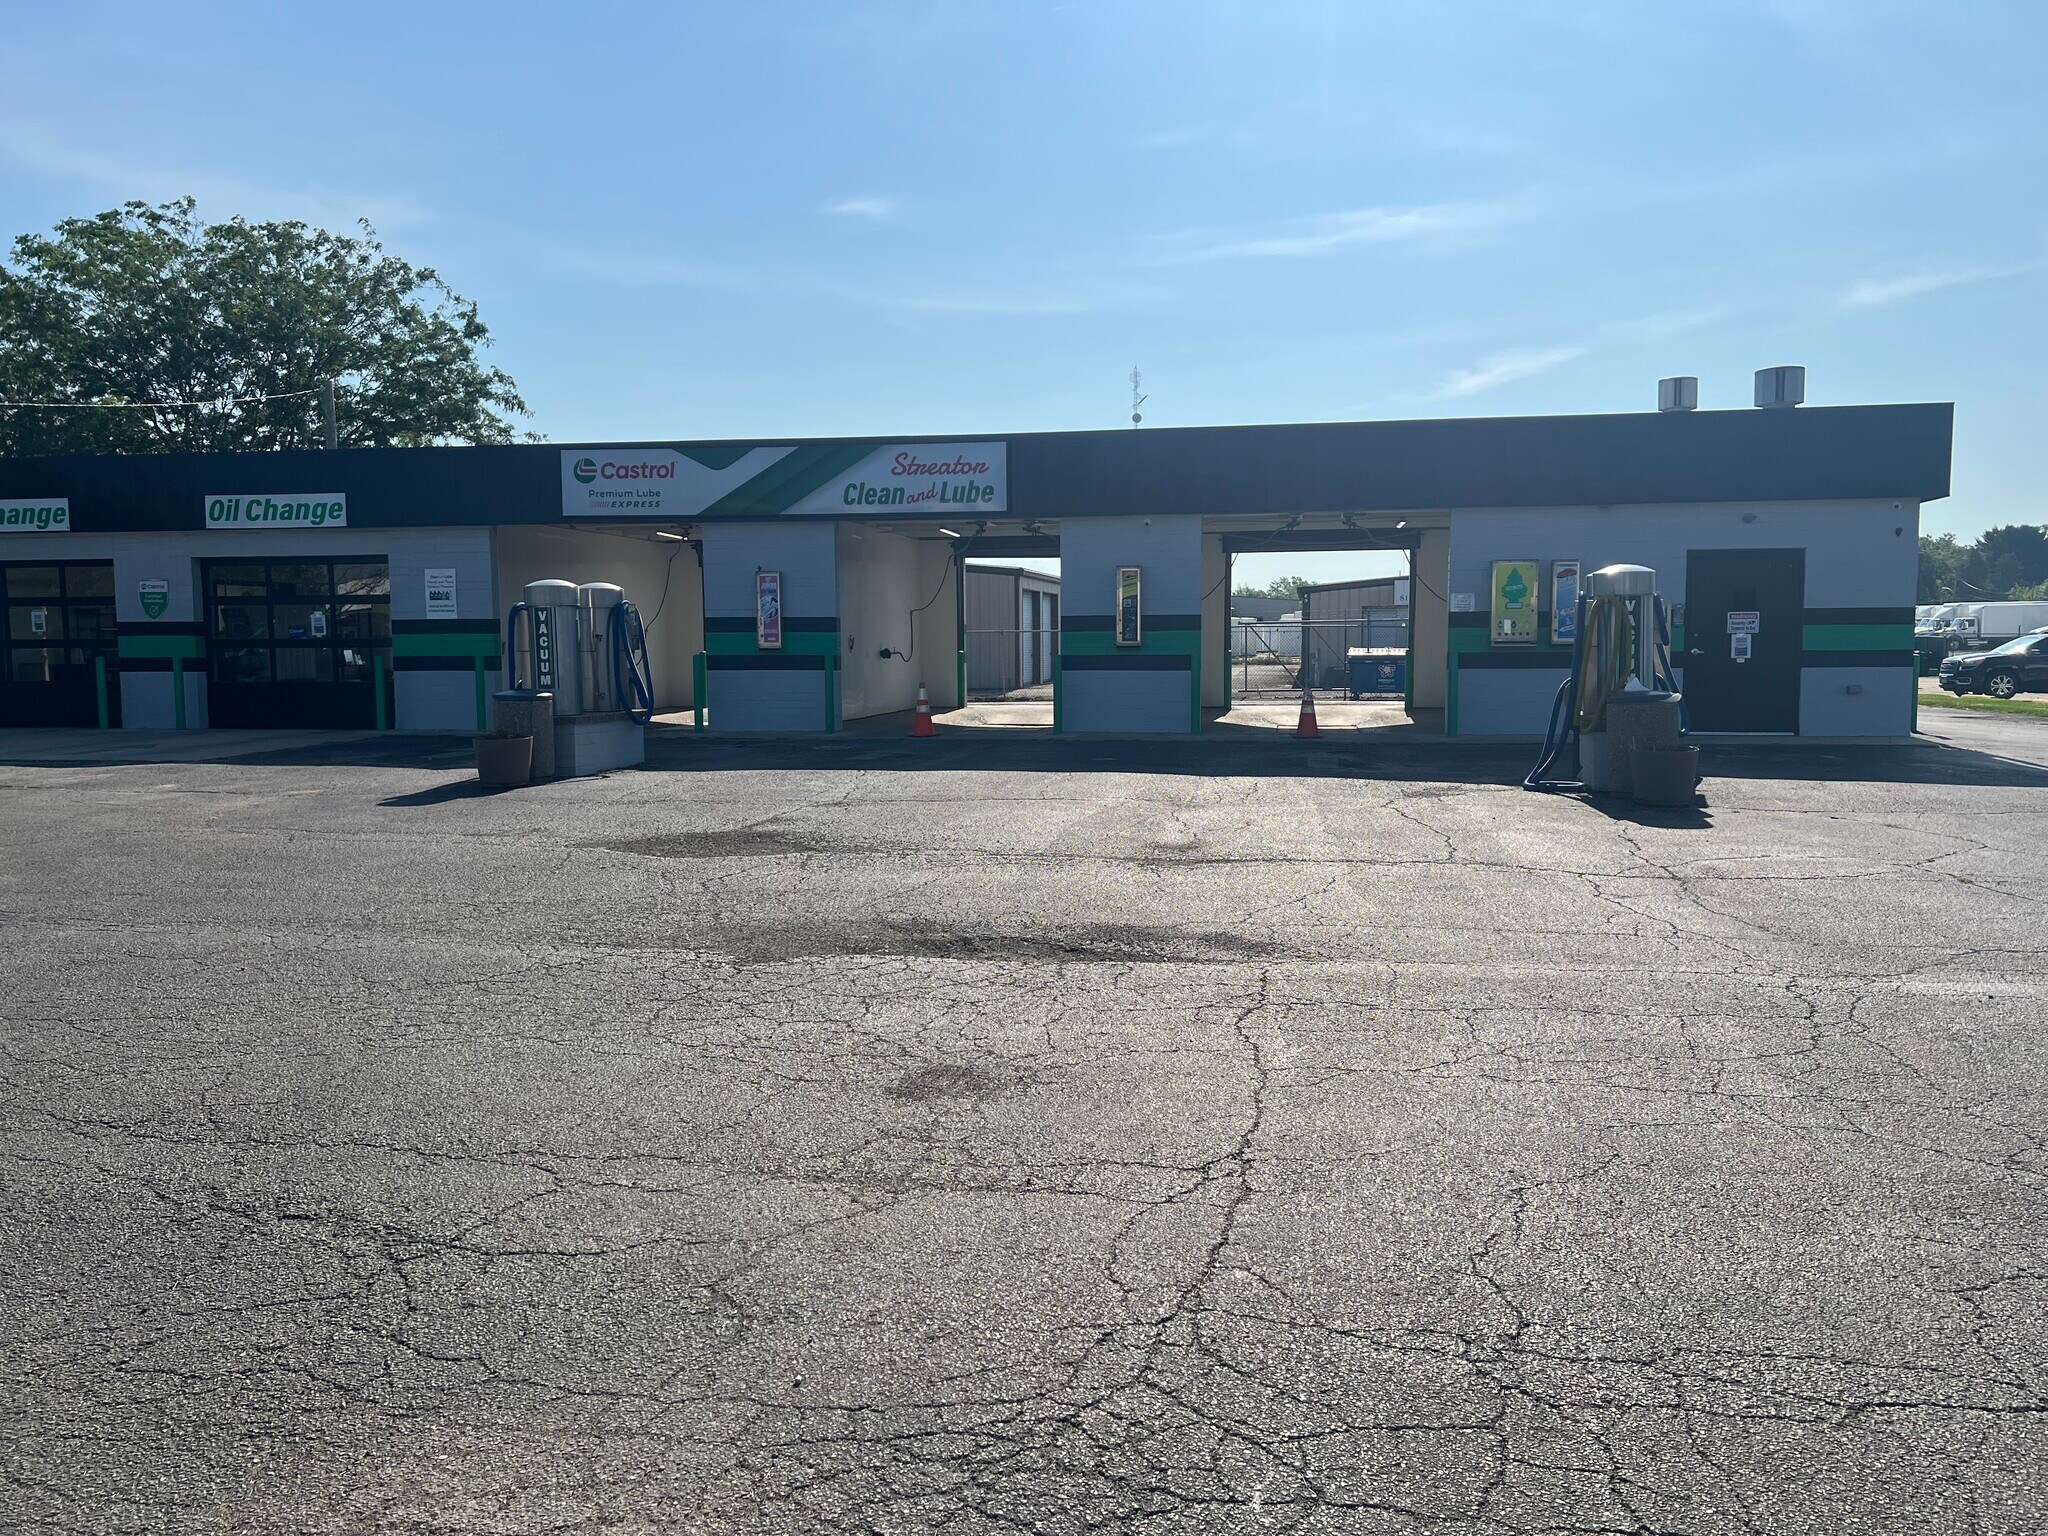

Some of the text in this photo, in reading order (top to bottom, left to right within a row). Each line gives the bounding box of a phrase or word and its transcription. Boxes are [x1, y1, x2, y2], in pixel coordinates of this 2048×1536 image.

[600, 461, 676, 480] Castrol
[890, 452, 990, 476] Streator
[588, 488, 661, 498] Premium Lube
[610, 500, 661, 508] EXPRESS
[843, 480, 995, 506] Clean and Lube
[208, 498, 344, 526] Oil Change
[537, 610, 552, 686] VACUUM
